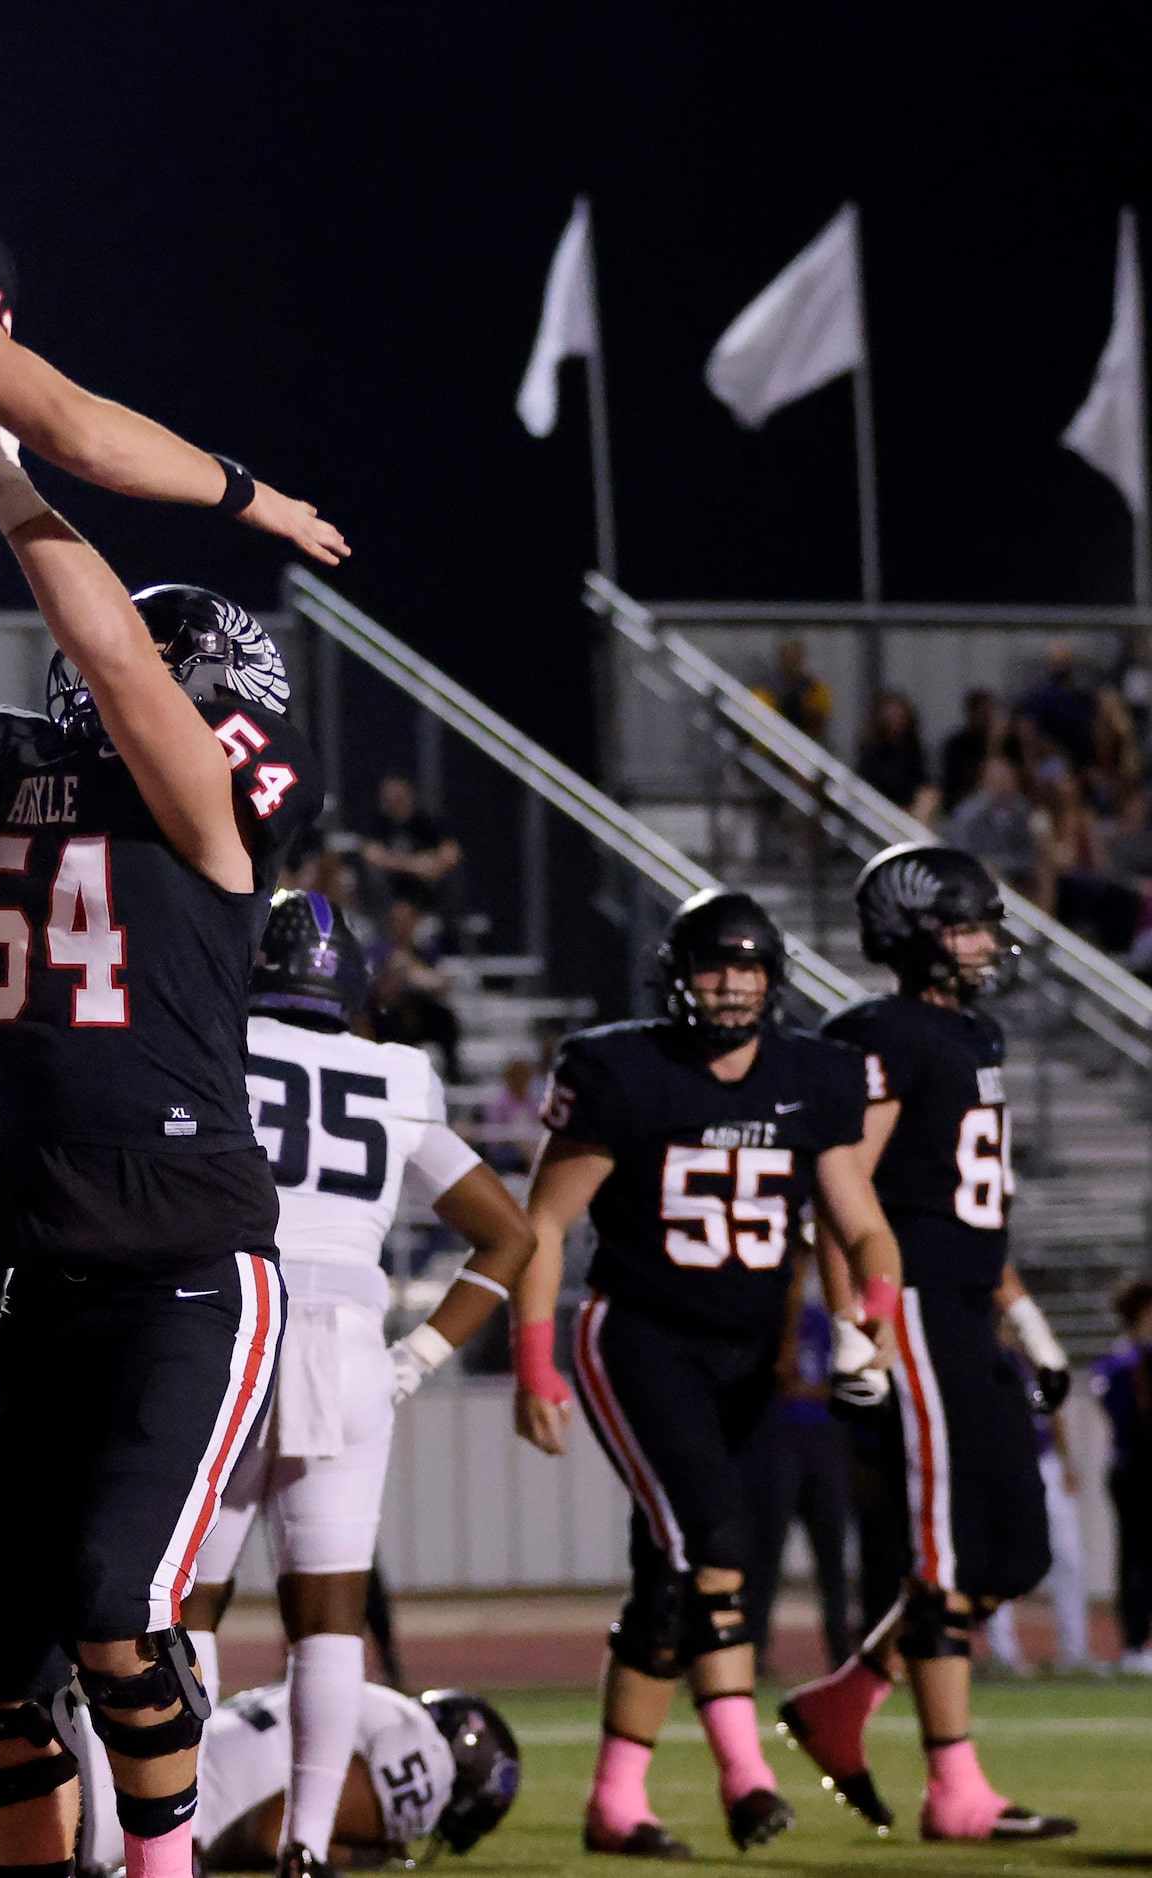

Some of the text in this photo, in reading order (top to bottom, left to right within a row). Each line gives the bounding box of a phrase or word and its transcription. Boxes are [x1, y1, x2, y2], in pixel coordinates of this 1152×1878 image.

[214, 709, 299, 819] 54
[170, 1107, 191, 1119] XL
[246, 1053, 388, 1202] 35
[660, 1145, 794, 1270] 55
[381, 1750, 433, 1816] 52
